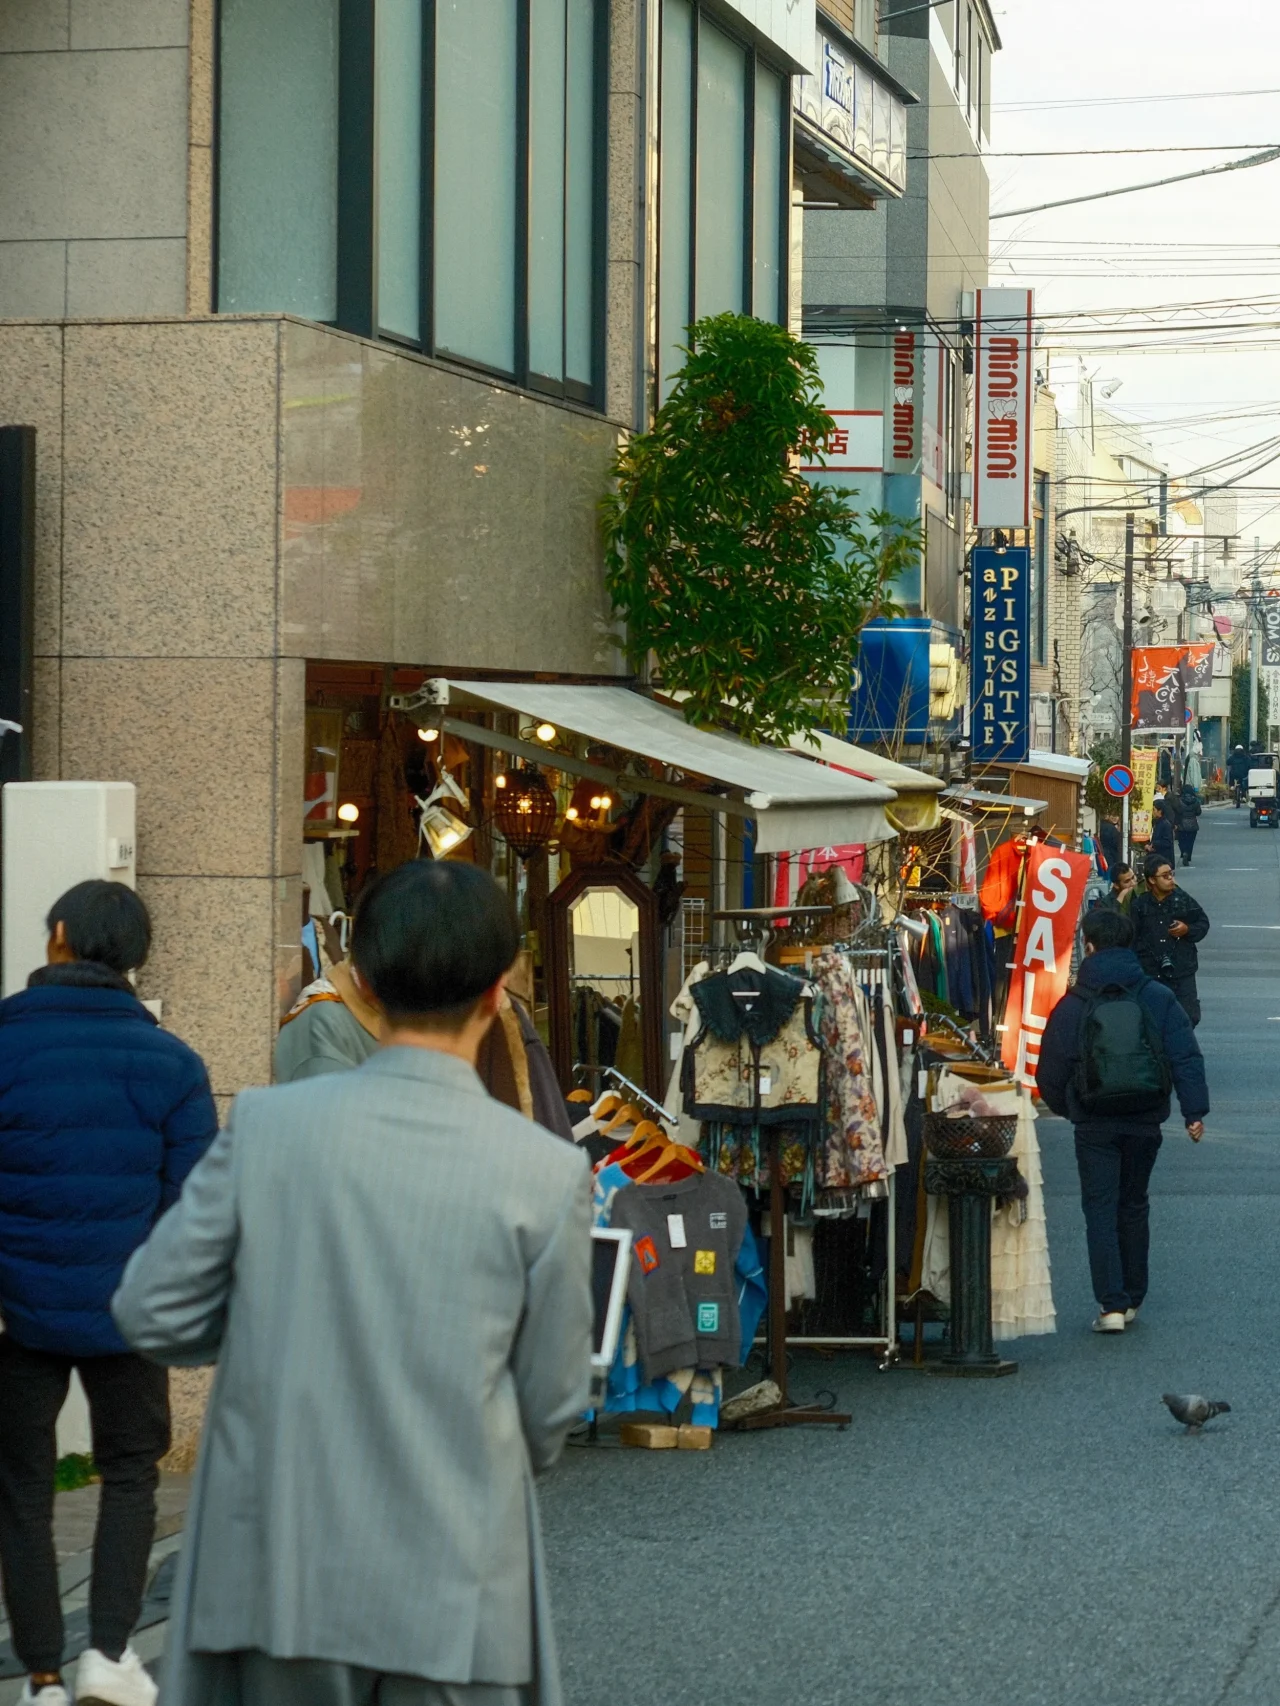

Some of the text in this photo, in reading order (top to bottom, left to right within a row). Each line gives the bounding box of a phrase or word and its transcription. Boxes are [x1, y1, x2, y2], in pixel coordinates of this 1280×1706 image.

[893, 331, 914, 459] mini mini
[986, 337, 1019, 479] mini mini
[983, 631, 996, 745] STORE
[998, 567, 1021, 744] PIGSTY
[1266, 602, 1280, 663] TOMS
[1014, 857, 1072, 1088] SALE
